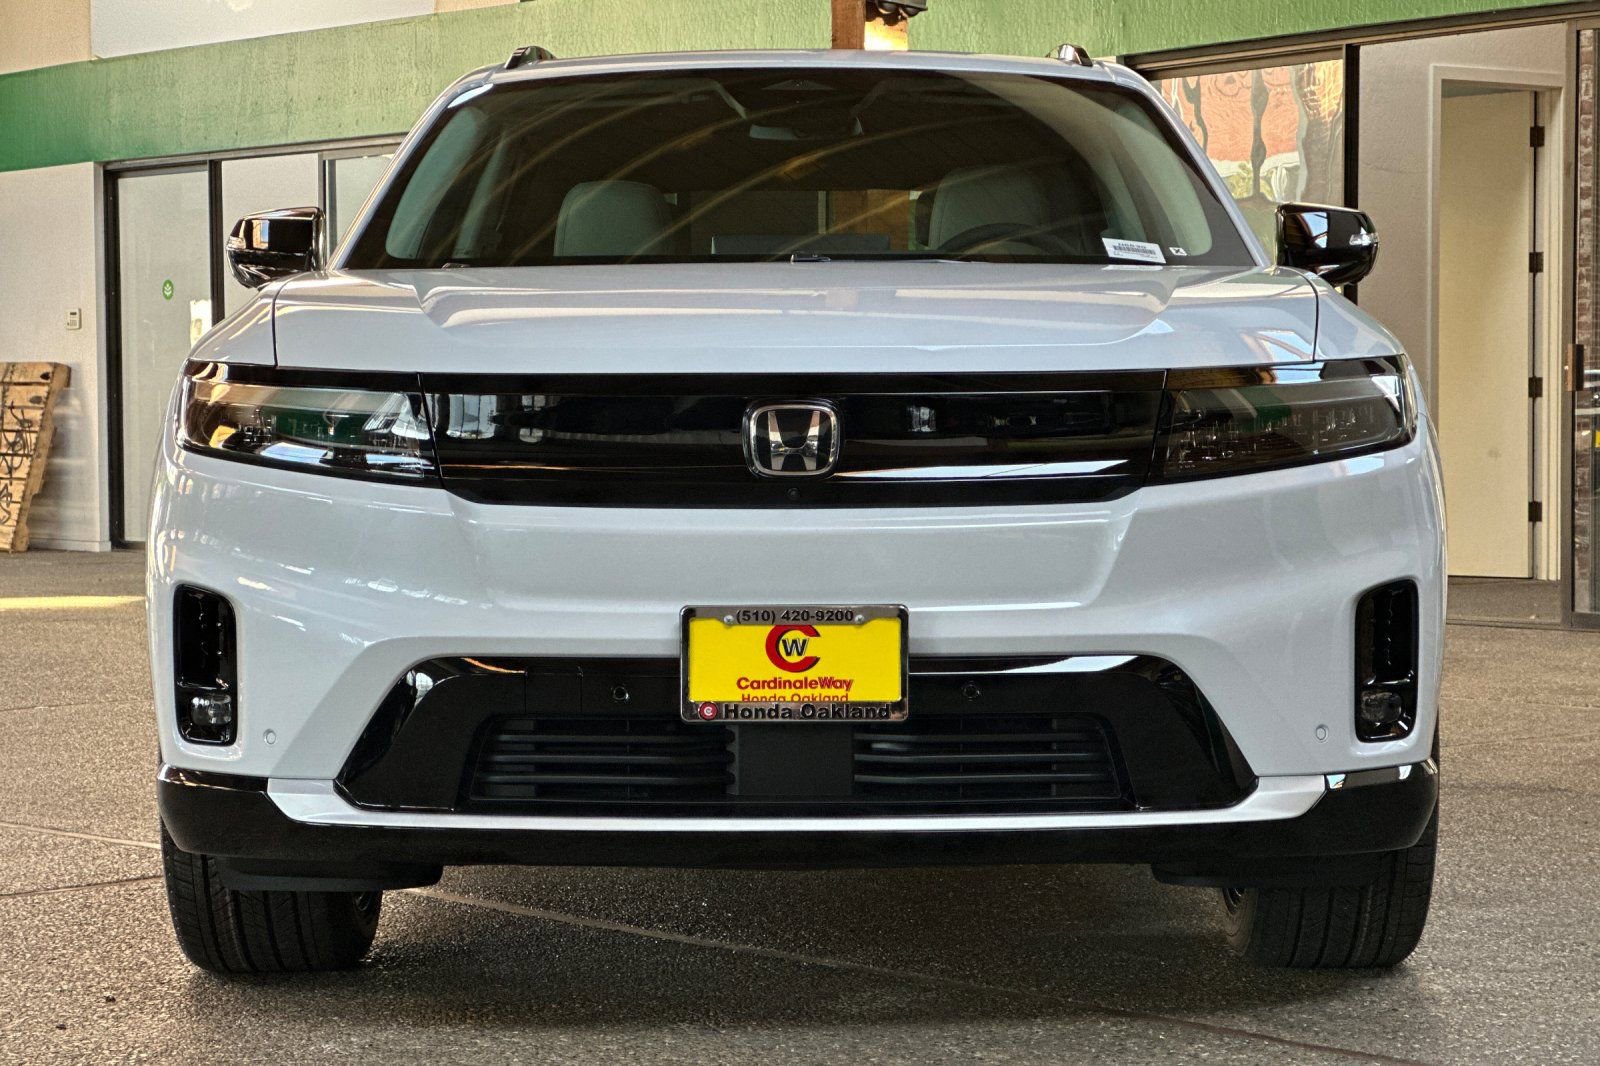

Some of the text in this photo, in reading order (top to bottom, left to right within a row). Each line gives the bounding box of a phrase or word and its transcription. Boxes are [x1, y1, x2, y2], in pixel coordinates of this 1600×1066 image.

[736, 610, 854, 624] (510) 420-9200
[736, 676, 853, 691] CardinaleWay
[741, 693, 849, 702] Honda Oakland
[723, 704, 891, 719] Honda Oakland
